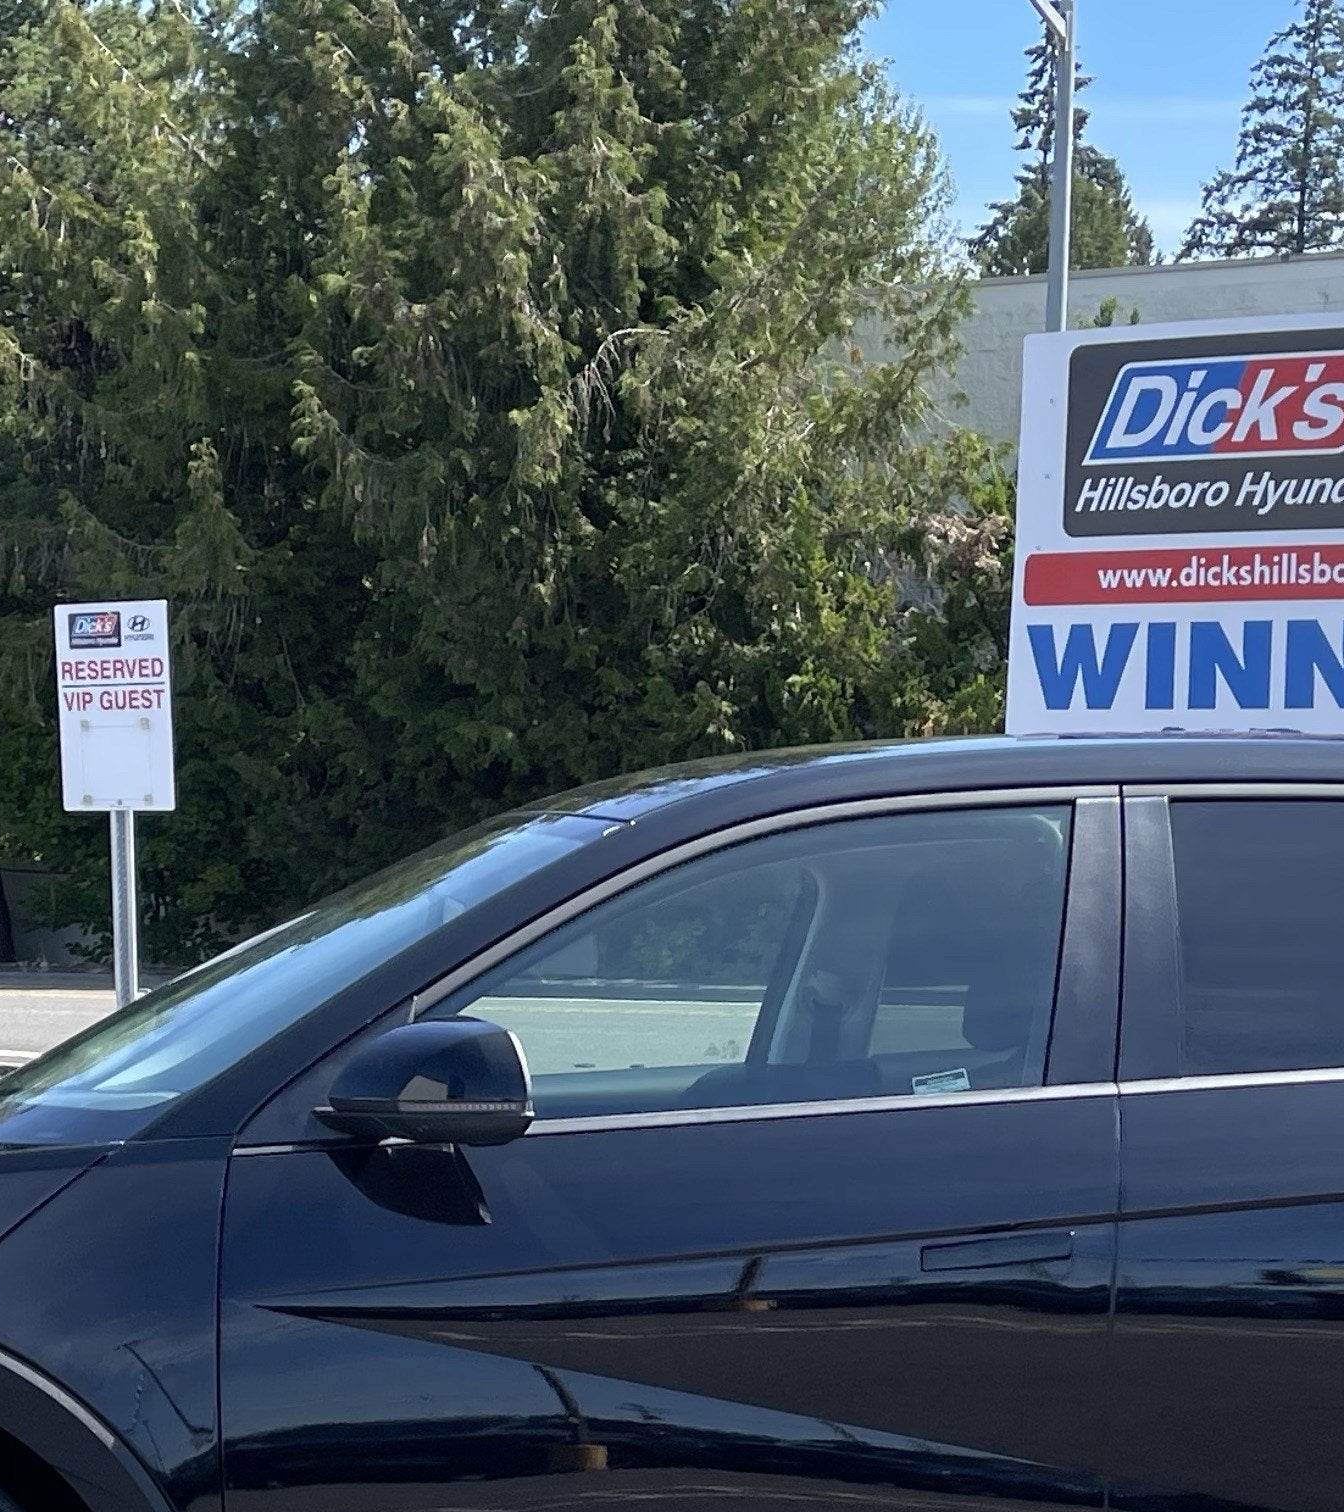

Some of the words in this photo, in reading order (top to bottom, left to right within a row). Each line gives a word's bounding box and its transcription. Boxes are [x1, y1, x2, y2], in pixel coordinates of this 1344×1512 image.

[1074, 474, 1231, 513] Hillsboro
[61, 657, 164, 681] RESERVED
[63, 691, 94, 712] VIP
[99, 688, 165, 711] GUEST
